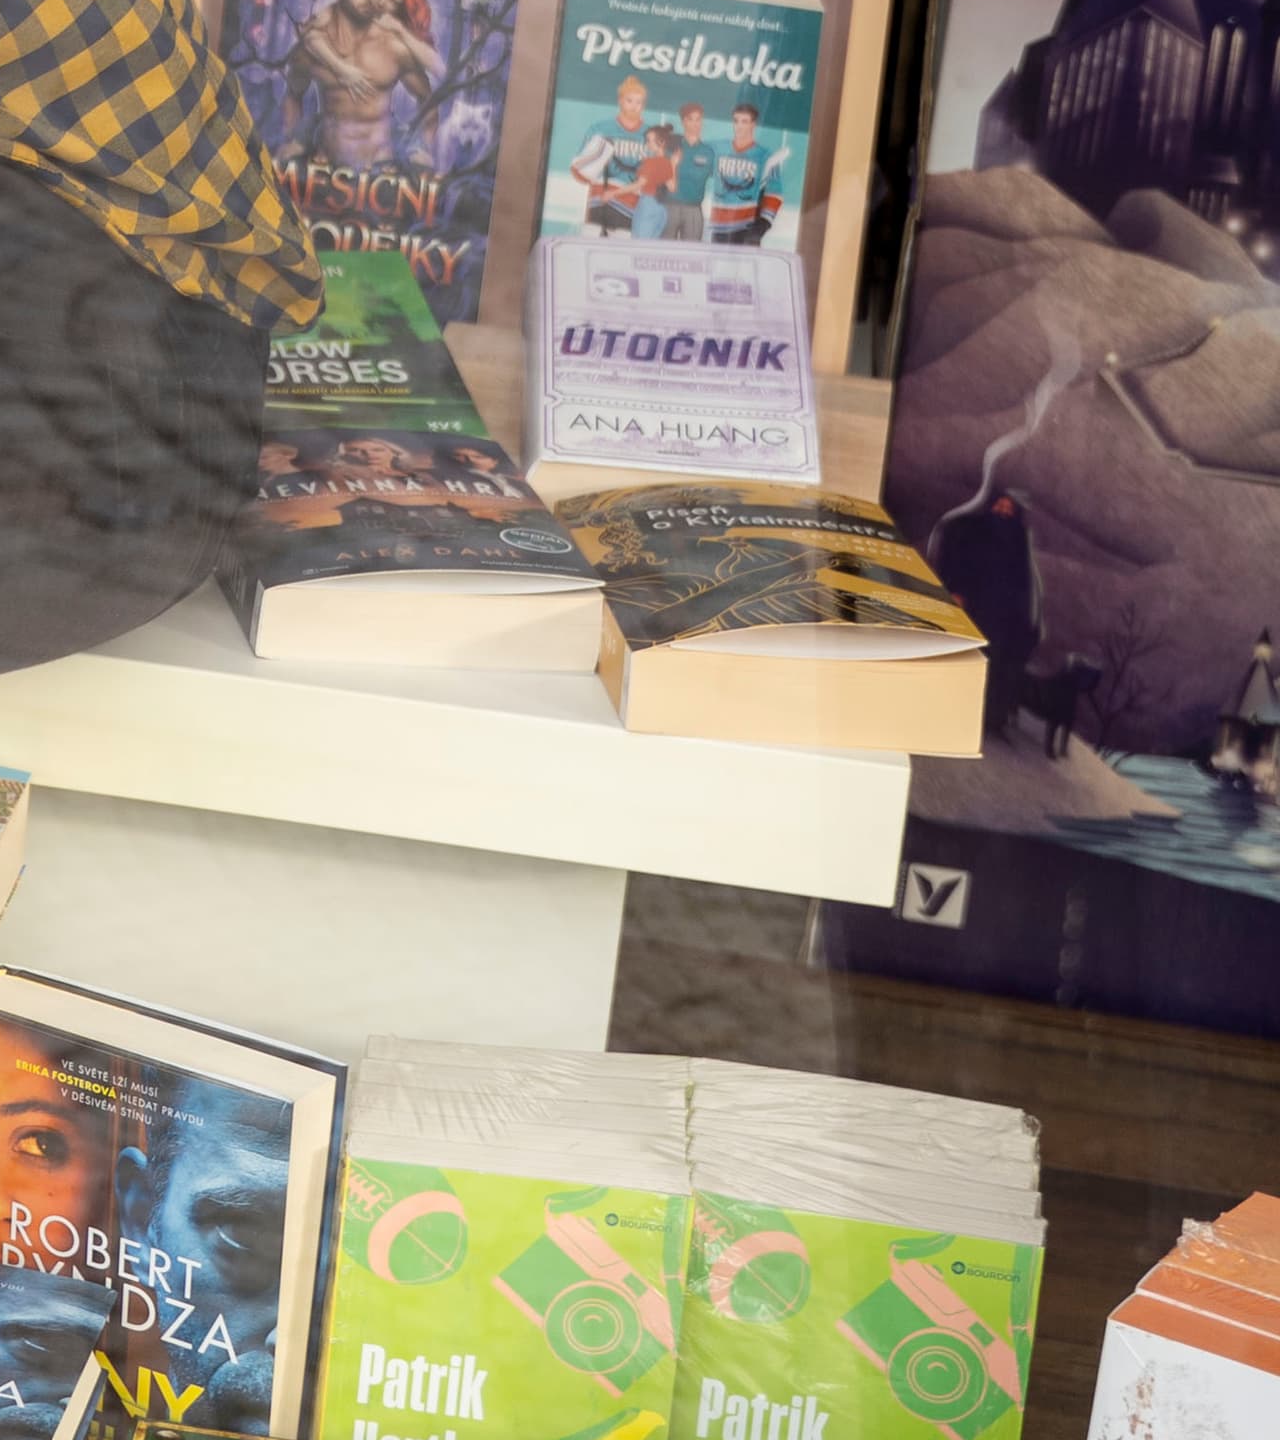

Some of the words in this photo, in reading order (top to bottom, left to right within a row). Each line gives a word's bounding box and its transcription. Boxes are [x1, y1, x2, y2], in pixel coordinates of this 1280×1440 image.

[577, 23, 803, 92] Přesilovka
[560, 323, 790, 371] ÚTOČNÍK
[569, 413, 644, 436] ANA
[660, 421, 790, 446] HUANG
[16, 1059, 49, 1078] ERIKA
[52, 1071, 117, 1099] FOSTEROVÁ
[120, 1094, 158, 1112] HLEDAT
[162, 1106, 204, 1127] PRAVDU
[130, 1082, 158, 1097] MUSÍ
[9, 1201, 202, 1301] ROBERT
[967, 1265, 1022, 1284] BOURDON
[357, 1342, 488, 1422] Patrik
